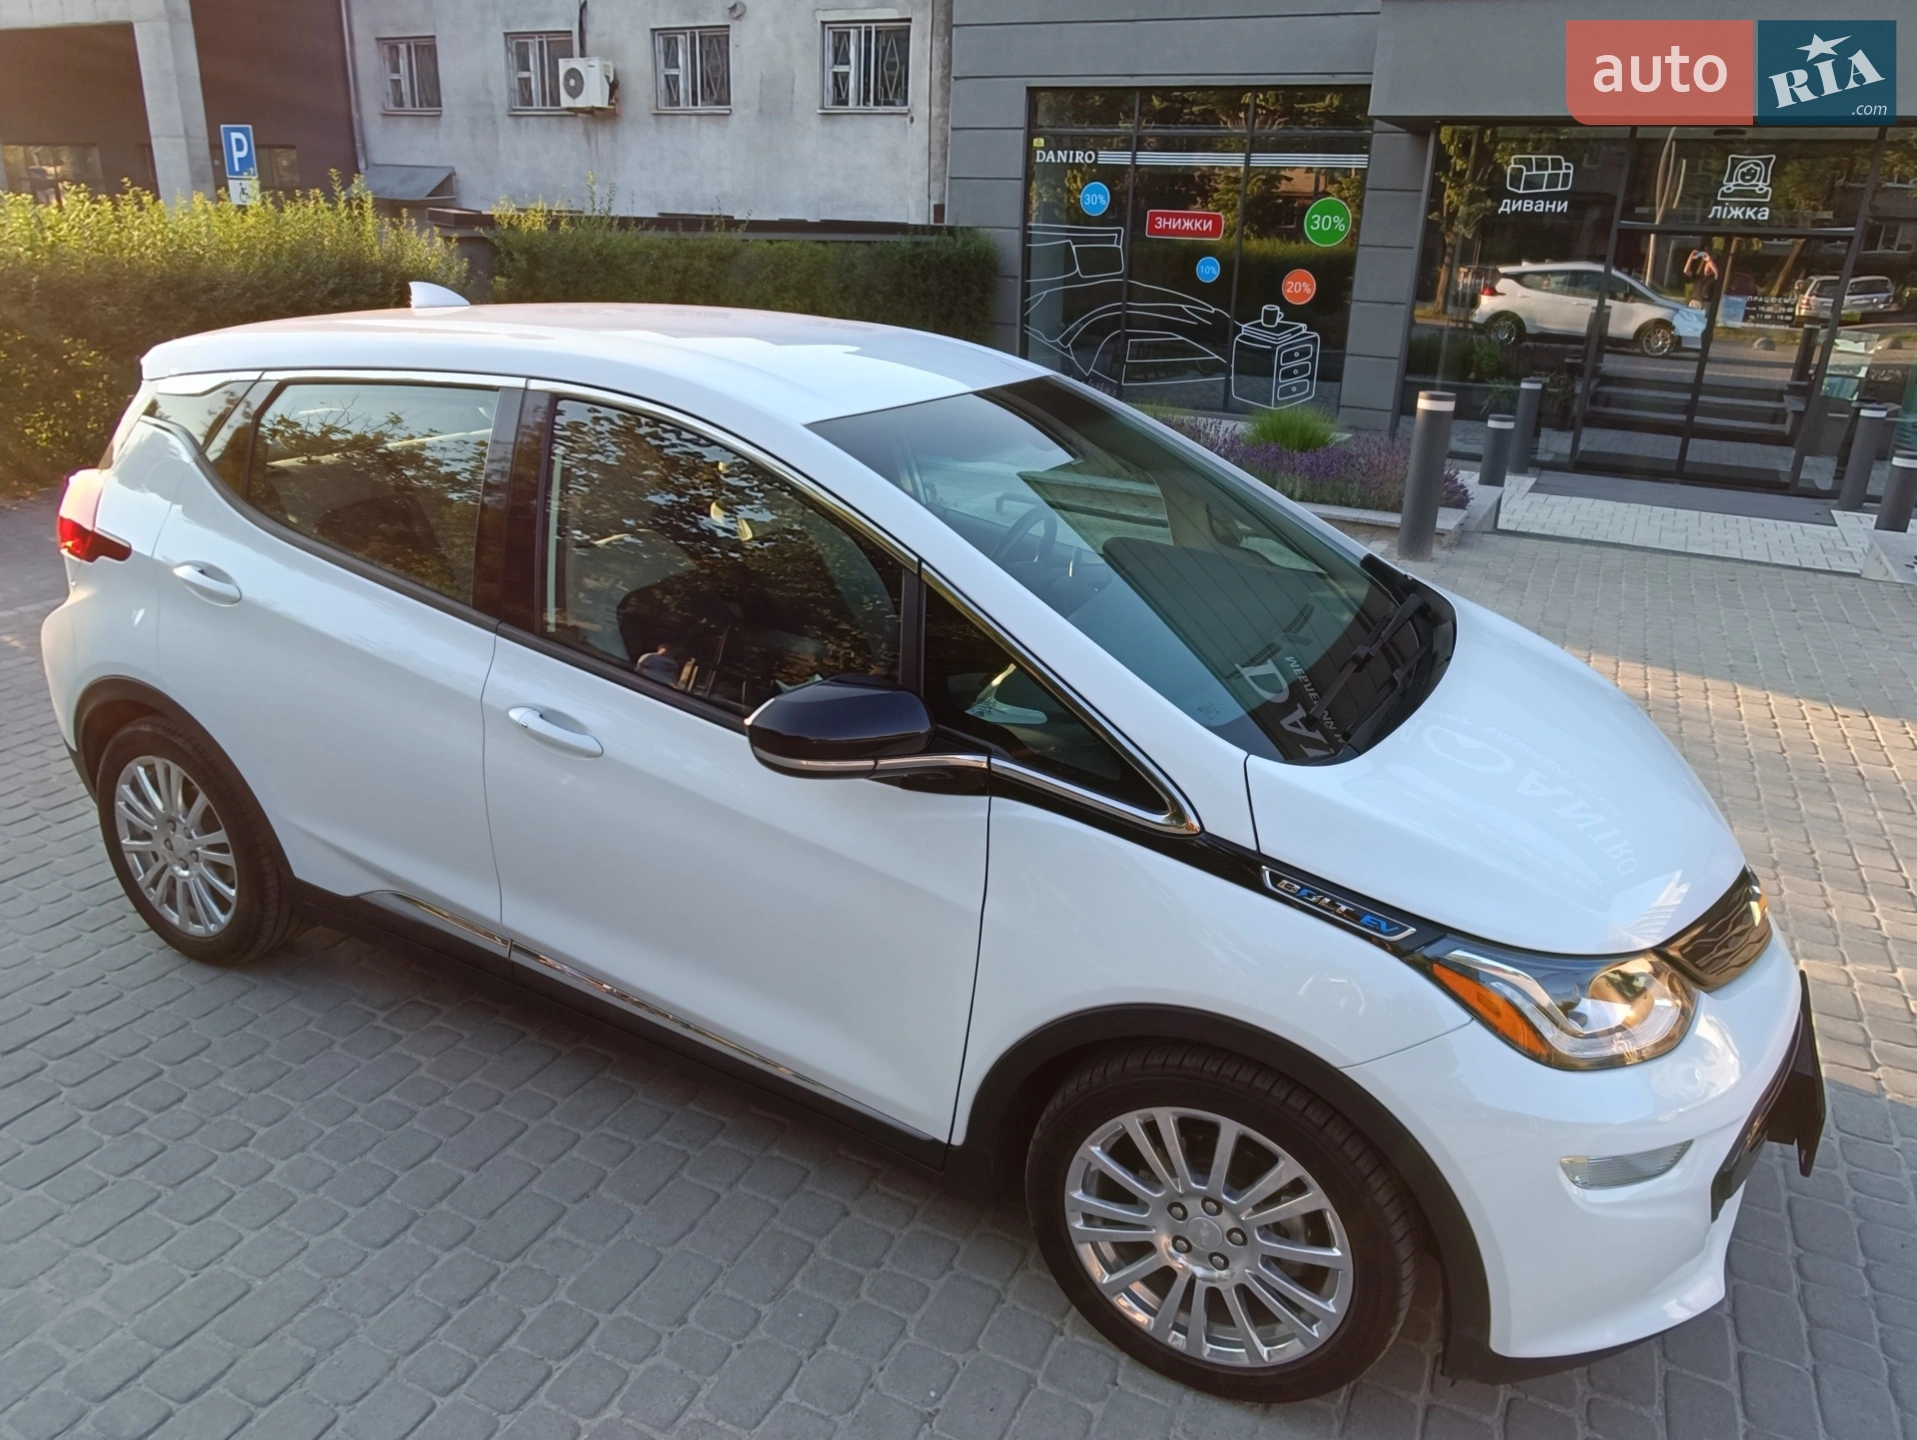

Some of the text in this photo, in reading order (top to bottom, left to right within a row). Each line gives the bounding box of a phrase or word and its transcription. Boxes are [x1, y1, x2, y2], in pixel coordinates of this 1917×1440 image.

[230, 132, 249, 172] P
[1035, 149, 1096, 164] DANIRO
[1083, 193, 1107, 206] 30%
[1498, 199, 1569, 214] дивани
[1708, 202, 1770, 220] ліжка
[1153, 217, 1213, 232] ЗНИЖКИ
[1309, 213, 1346, 233] 30%
[1199, 264, 1218, 276] 10%
[1286, 281, 1312, 295] 20%
[1359, 914, 1400, 933] EV
